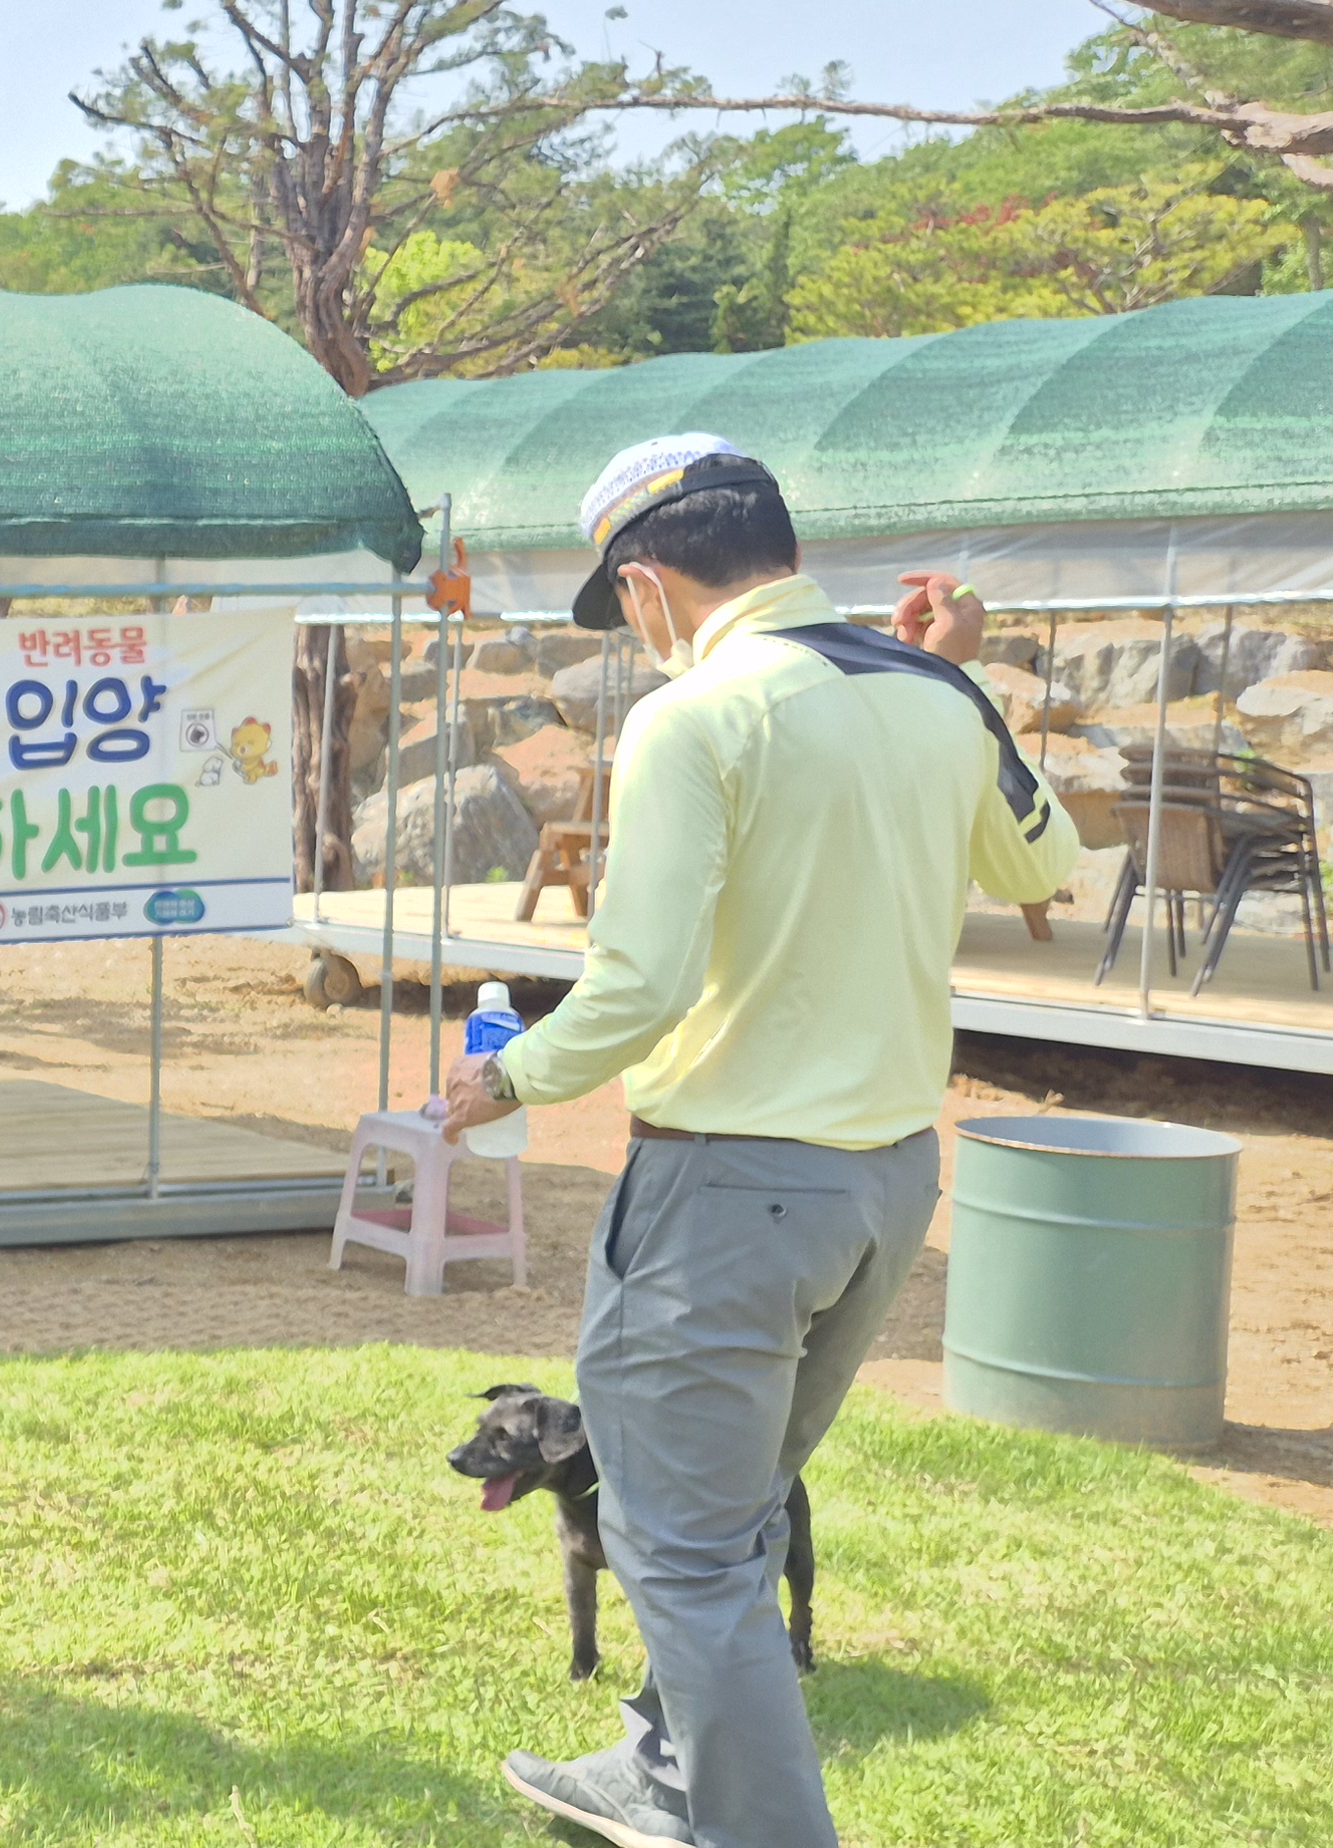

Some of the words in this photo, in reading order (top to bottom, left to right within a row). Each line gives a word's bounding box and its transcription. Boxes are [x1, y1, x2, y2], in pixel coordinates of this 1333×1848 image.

[18, 626, 148, 668] 반려동물
[5, 675, 167, 771] 입양
[10, 901, 128, 928] 농림축산식품부
